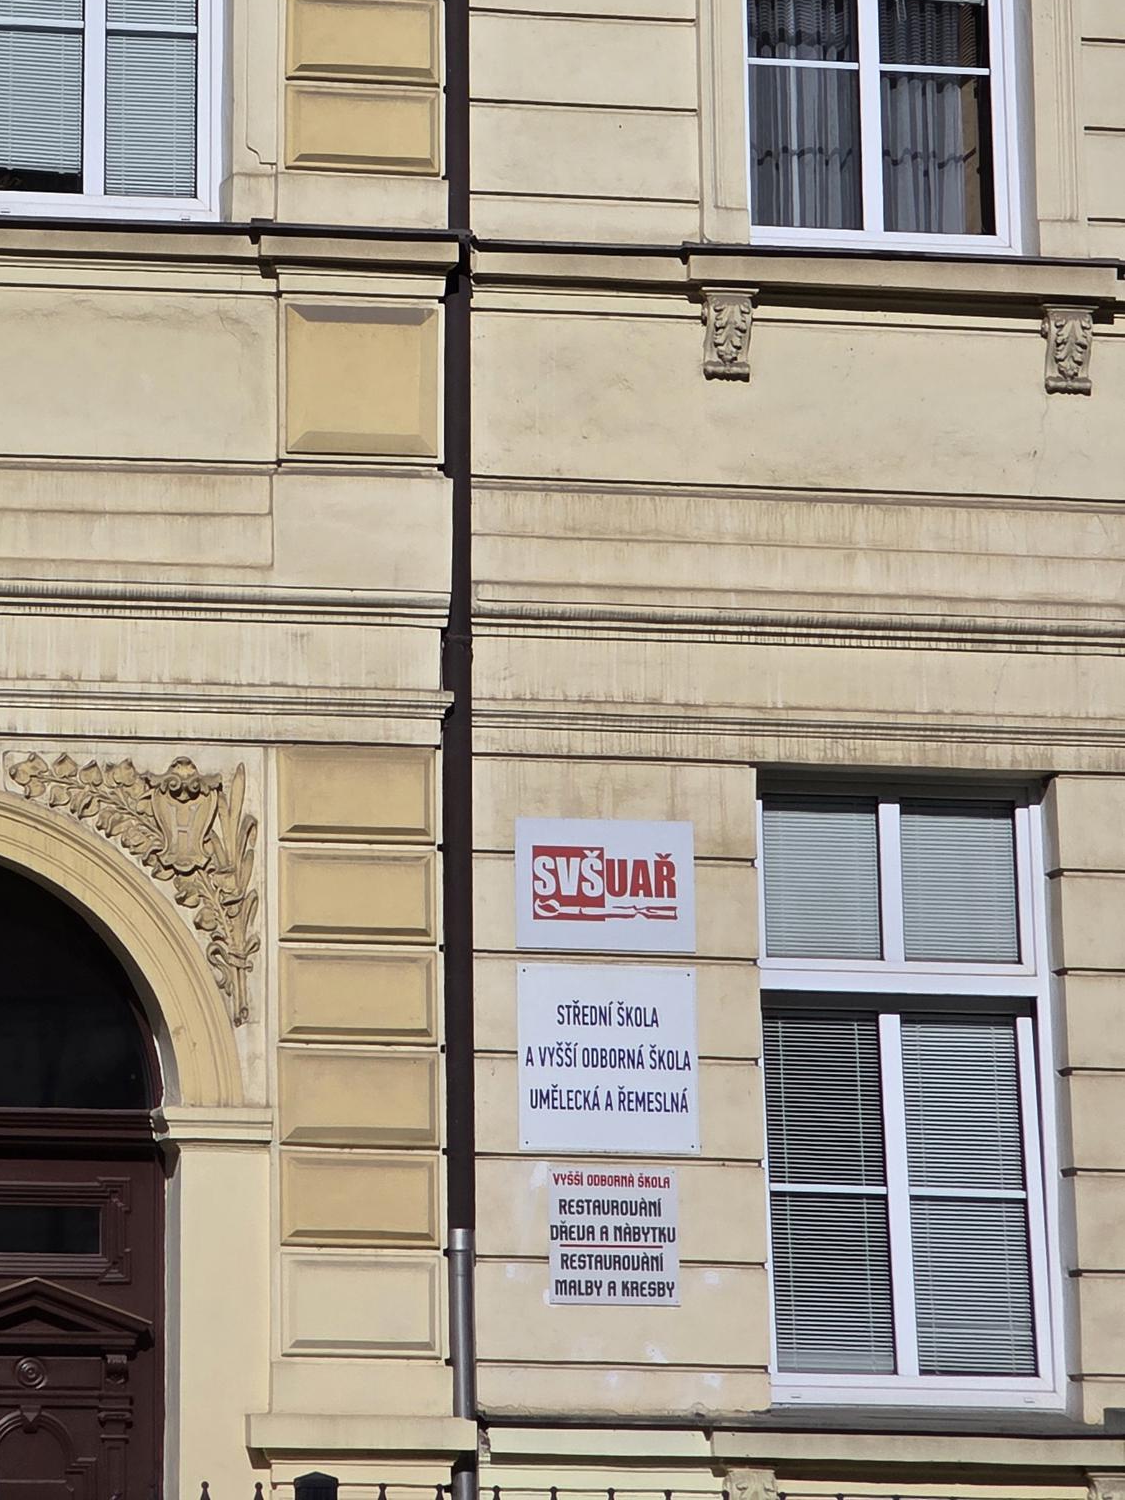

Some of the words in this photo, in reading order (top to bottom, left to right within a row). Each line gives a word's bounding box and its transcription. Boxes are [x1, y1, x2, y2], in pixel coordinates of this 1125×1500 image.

[557, 1000, 614, 1027] STŘEDNÍ
[617, 1001, 659, 1028] ŠKOLA
[525, 1046, 534, 1067] A
[538, 1041, 578, 1068] VYŠŠÍ
[582, 1044, 645, 1070] ODBORNÁ
[649, 1044, 692, 1071] ŠKOLA
[530, 1084, 601, 1111] UMĚLECKÁ
[605, 1090, 614, 1111] A
[618, 1085, 689, 1113] ŘEMESLNÁ
[553, 1171, 583, 1186] VYŠŠÍ
[638, 1173, 670, 1188] ŠKOLA
[550, 1220, 595, 1241] DŘEVA
[600, 1225, 609, 1242] A
[555, 1279, 603, 1297] MALBY
[608, 1280, 617, 1297] A
[622, 1281, 675, 1298] KRESBY
